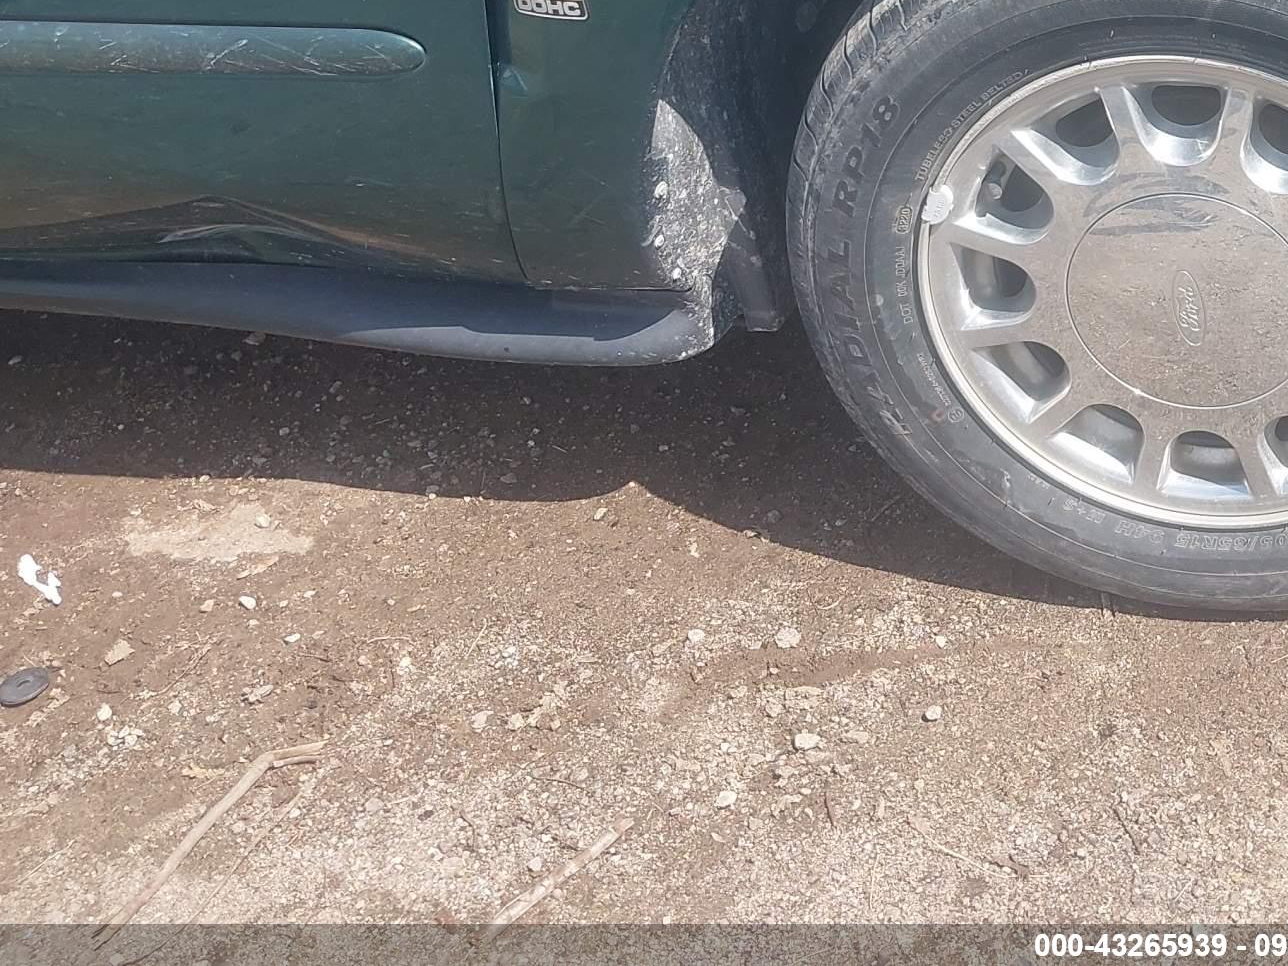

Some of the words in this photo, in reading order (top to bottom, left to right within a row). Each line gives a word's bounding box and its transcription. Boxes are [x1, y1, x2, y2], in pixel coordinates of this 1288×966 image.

[951, 100, 982, 129] STEEL
[981, 72, 1024, 101] BELTED
[831, 95, 900, 218] RP18
[902, 302, 914, 325] DOT
[1176, 285, 1201, 333] Ford
[826, 239, 912, 436] RADIAL
[1062, 498, 1107, 524] M+S
[1115, 521, 1166, 544] 94H
